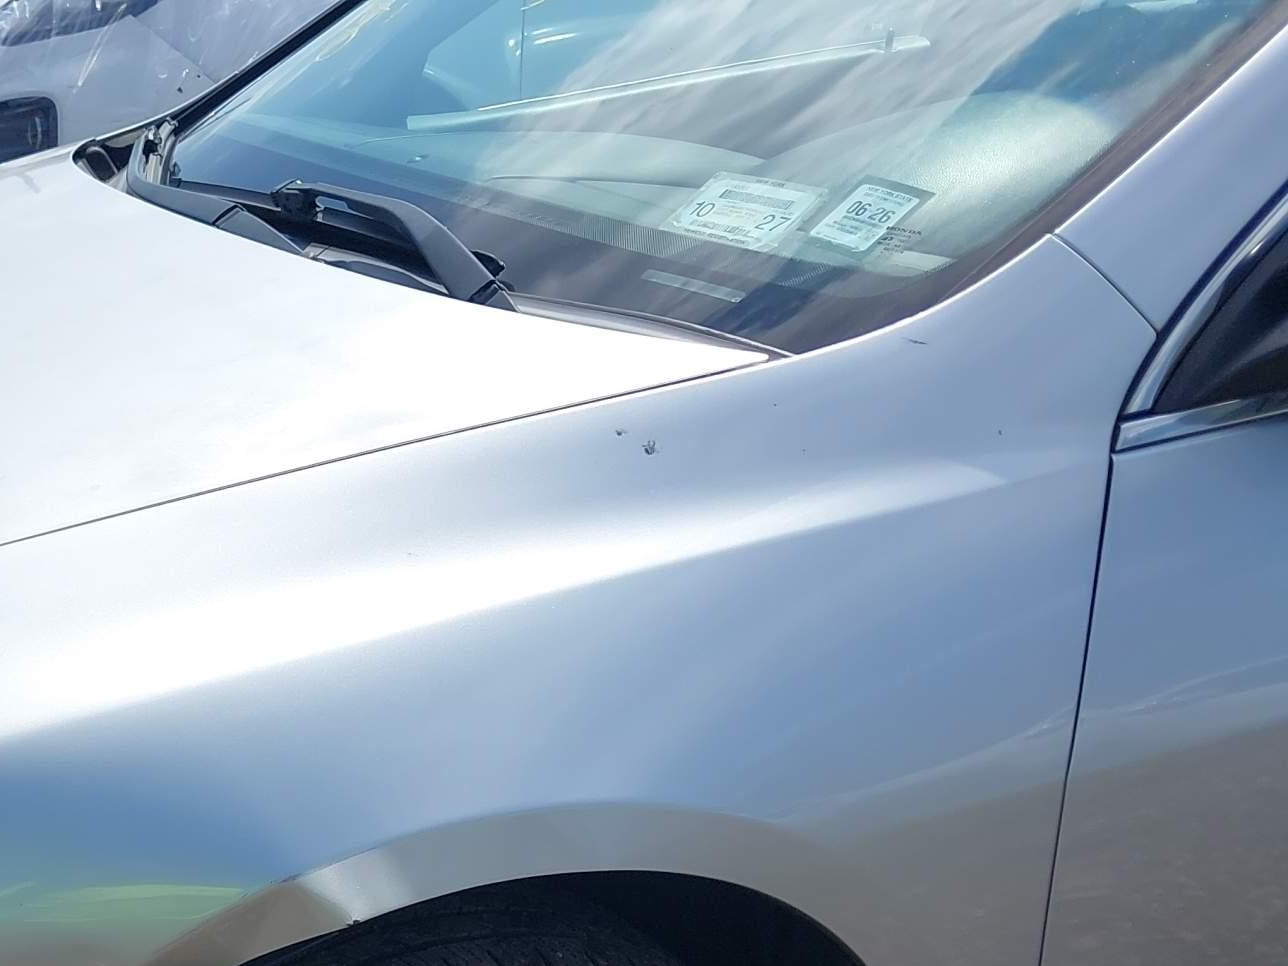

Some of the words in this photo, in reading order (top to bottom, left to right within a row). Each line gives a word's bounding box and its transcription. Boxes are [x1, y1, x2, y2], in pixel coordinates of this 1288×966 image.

[689, 200, 716, 217] 10
[754, 214, 792, 231] 27
[845, 200, 873, 217] 06
[867, 207, 896, 224] 26
